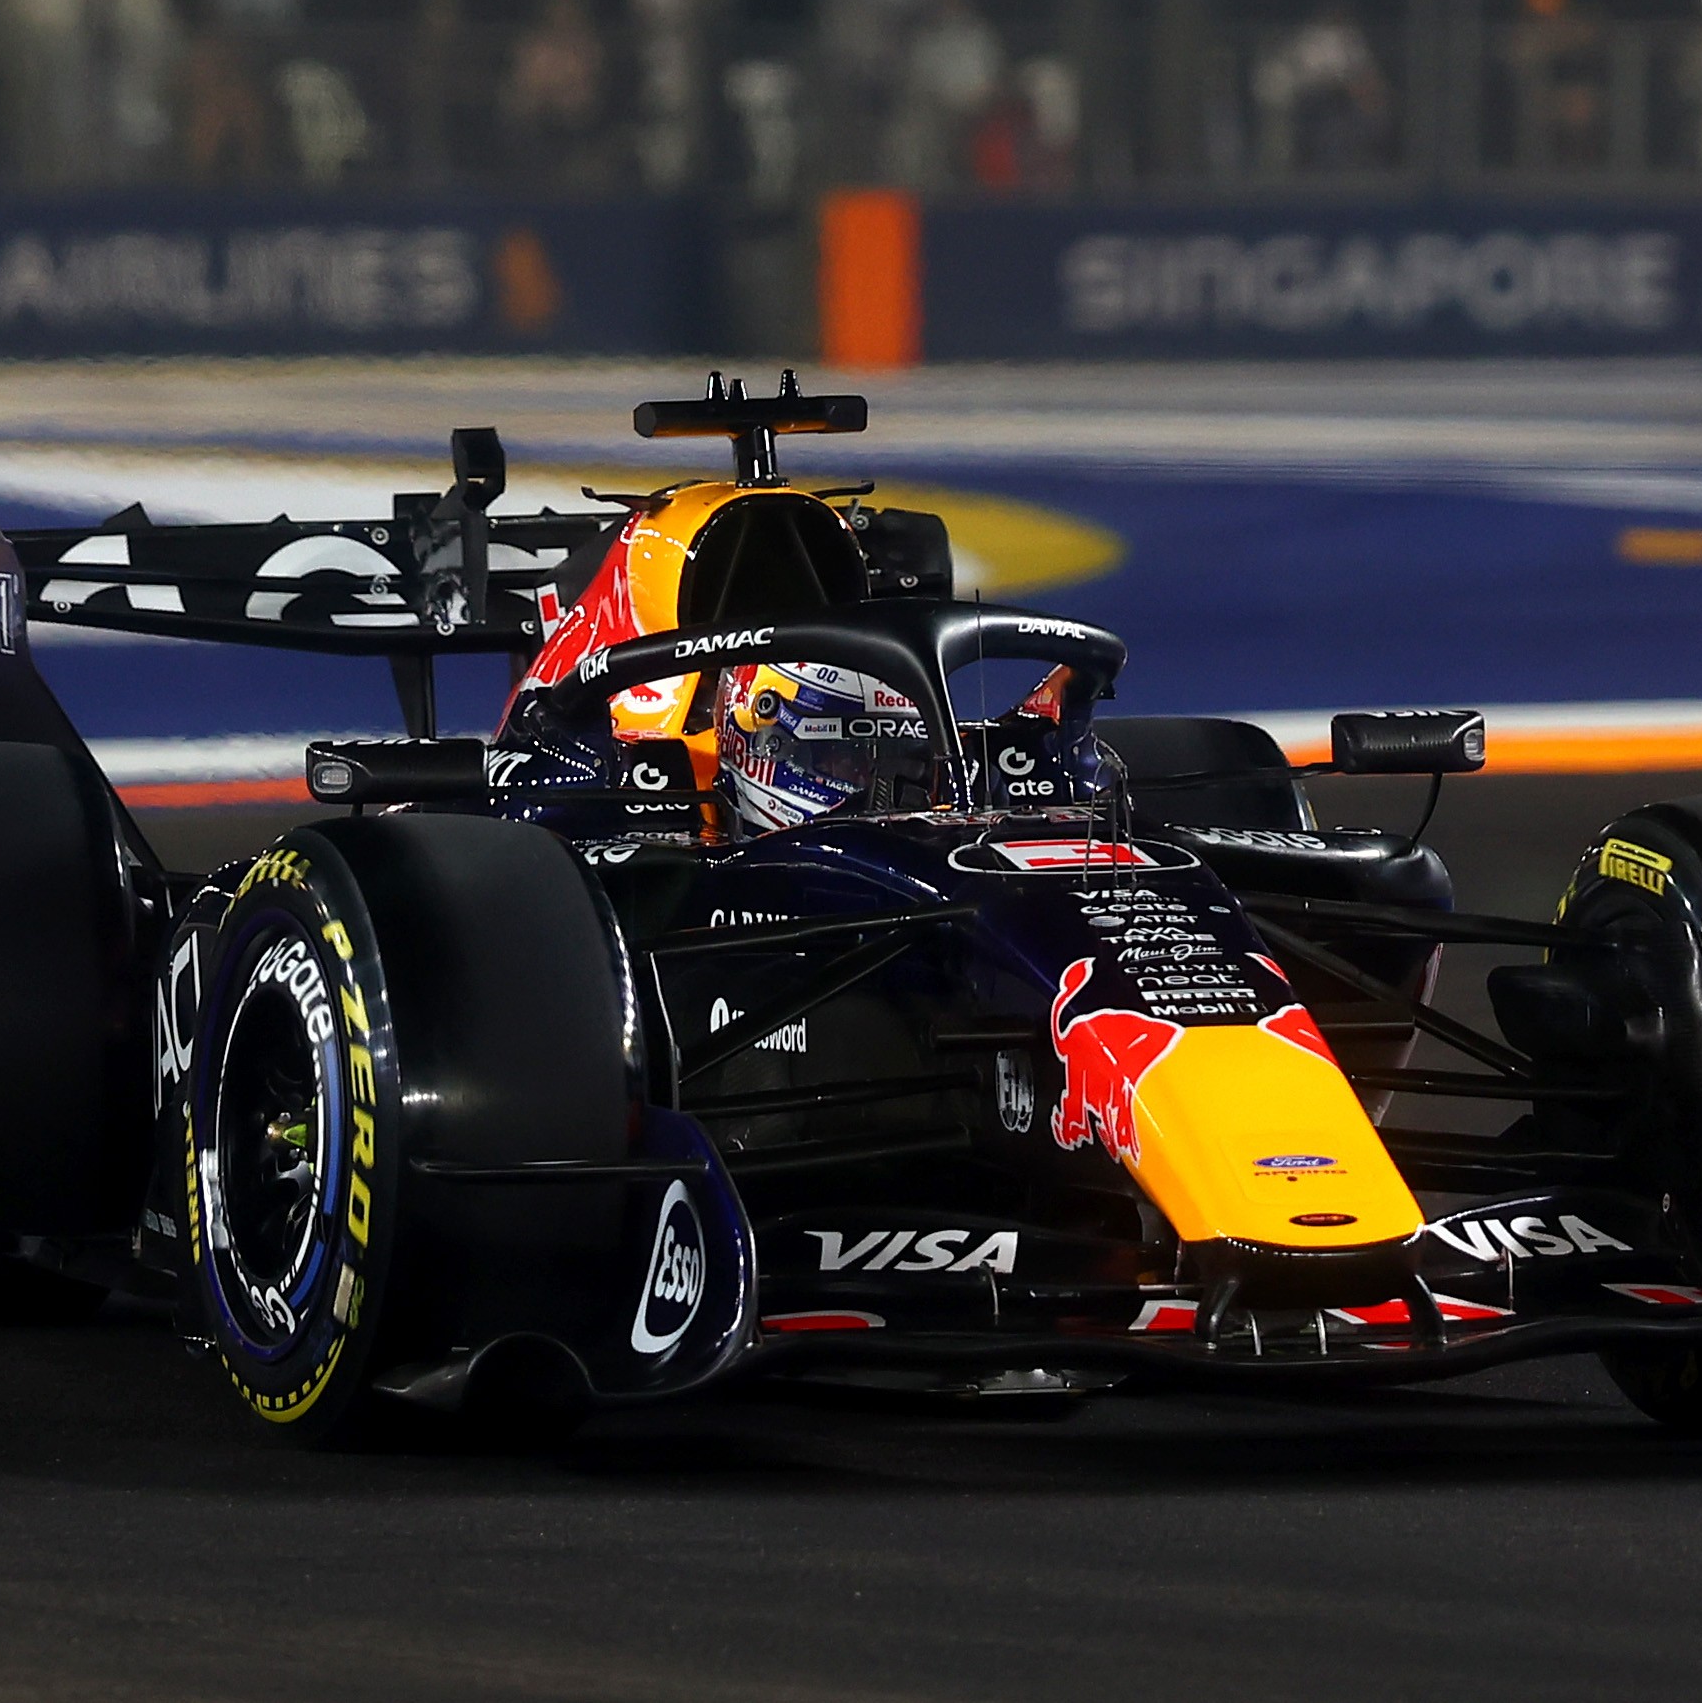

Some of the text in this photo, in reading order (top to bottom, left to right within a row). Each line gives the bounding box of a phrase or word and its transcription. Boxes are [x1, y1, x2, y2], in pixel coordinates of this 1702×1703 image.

[1059, 232, 1677, 333] SINGAPORE
[1018, 618, 1087, 640] DAMAC
[675, 627, 775, 659] DAMAC
[579, 647, 611, 684] VISA
[779, 709, 797, 728] VISA
[804, 724, 827, 733] Mobil
[1008, 780, 1054, 796] ate
[1599, 838, 1674, 896] PIRELLI
[1068, 888, 1159, 899] VISA
[1133, 914, 1198, 924] AT&T
[1100, 933, 1217, 944] TRADE
[1124, 926, 1186, 936] AVA
[1124, 963, 1241, 974] CARLYLE
[1136, 973, 1245, 988] neat.
[1140, 987, 1258, 1001] PIRELLI
[1150, 1002, 1236, 1016] Mobil
[322, 919, 355, 961] P
[340, 982, 377, 1249] ZERO
[1270, 1155, 1319, 1167] Ford
[1423, 1215, 1634, 1263] VISA
[803, 1230, 1019, 1274] VISA
[654, 1224, 700, 1307] Esso
